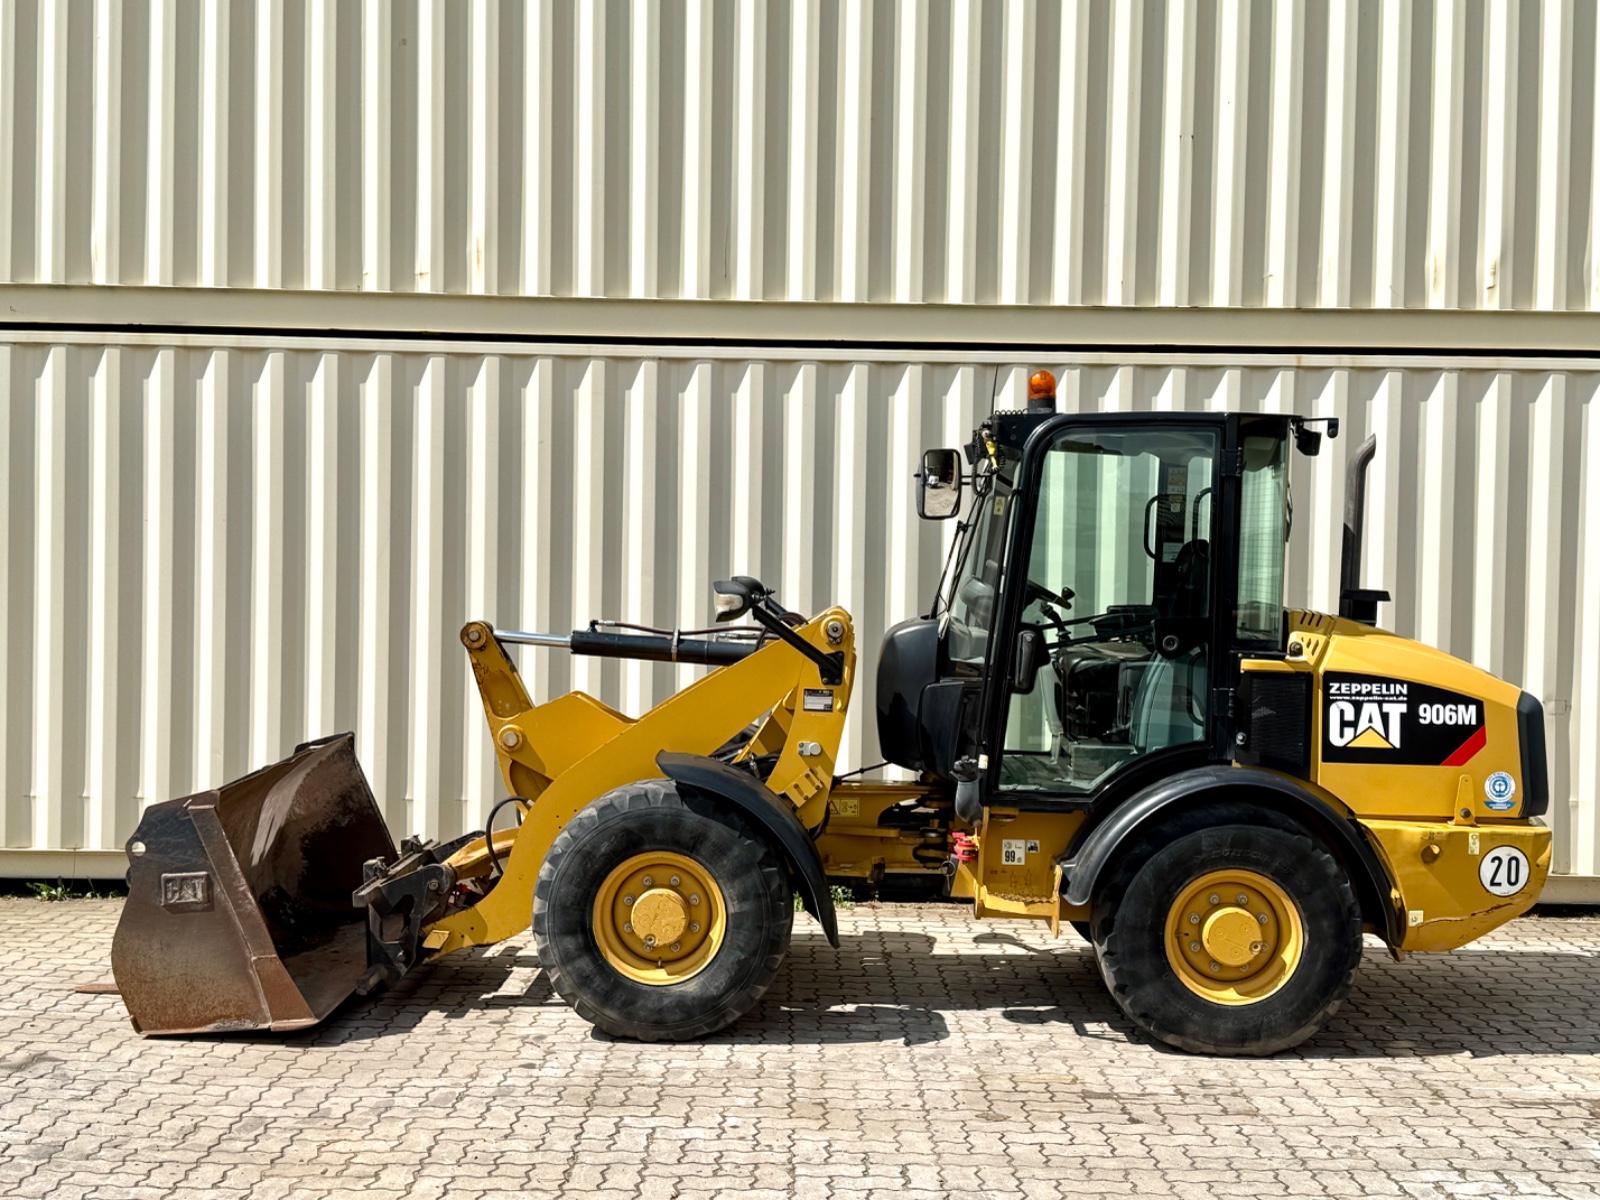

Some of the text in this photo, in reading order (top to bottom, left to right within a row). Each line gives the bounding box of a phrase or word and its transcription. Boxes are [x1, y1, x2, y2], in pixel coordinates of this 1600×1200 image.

[1329, 683, 1408, 695] ZEPPELIN
[1329, 701, 1408, 749] CAT
[1418, 703, 1477, 726] 906M
[1004, 850, 1016, 863] 99
[1489, 855, 1520, 887] 20
[166, 879, 206, 904] CAT
